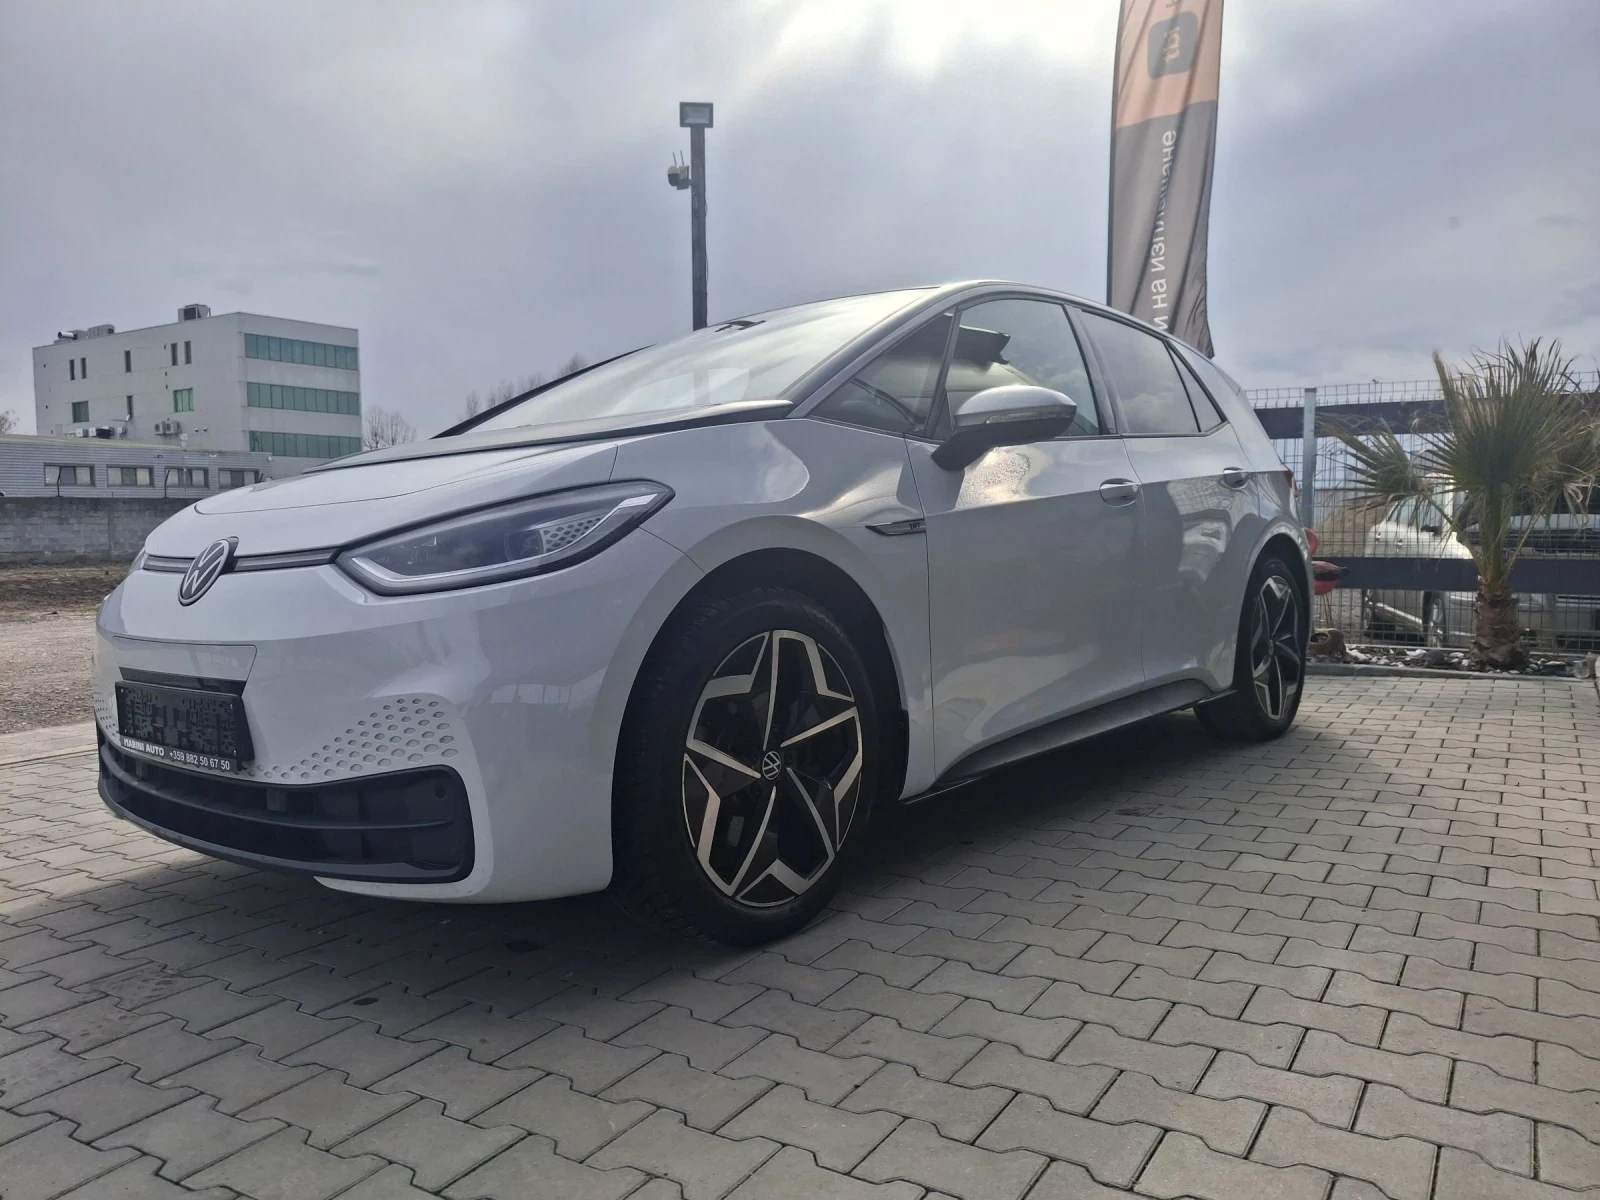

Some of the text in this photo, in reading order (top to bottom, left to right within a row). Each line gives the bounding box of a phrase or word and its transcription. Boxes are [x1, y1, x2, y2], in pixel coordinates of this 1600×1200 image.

[1151, 278, 1168, 309] на
[123, 738, 230, 770] MARINI AUTO +359 882 50 67 50
